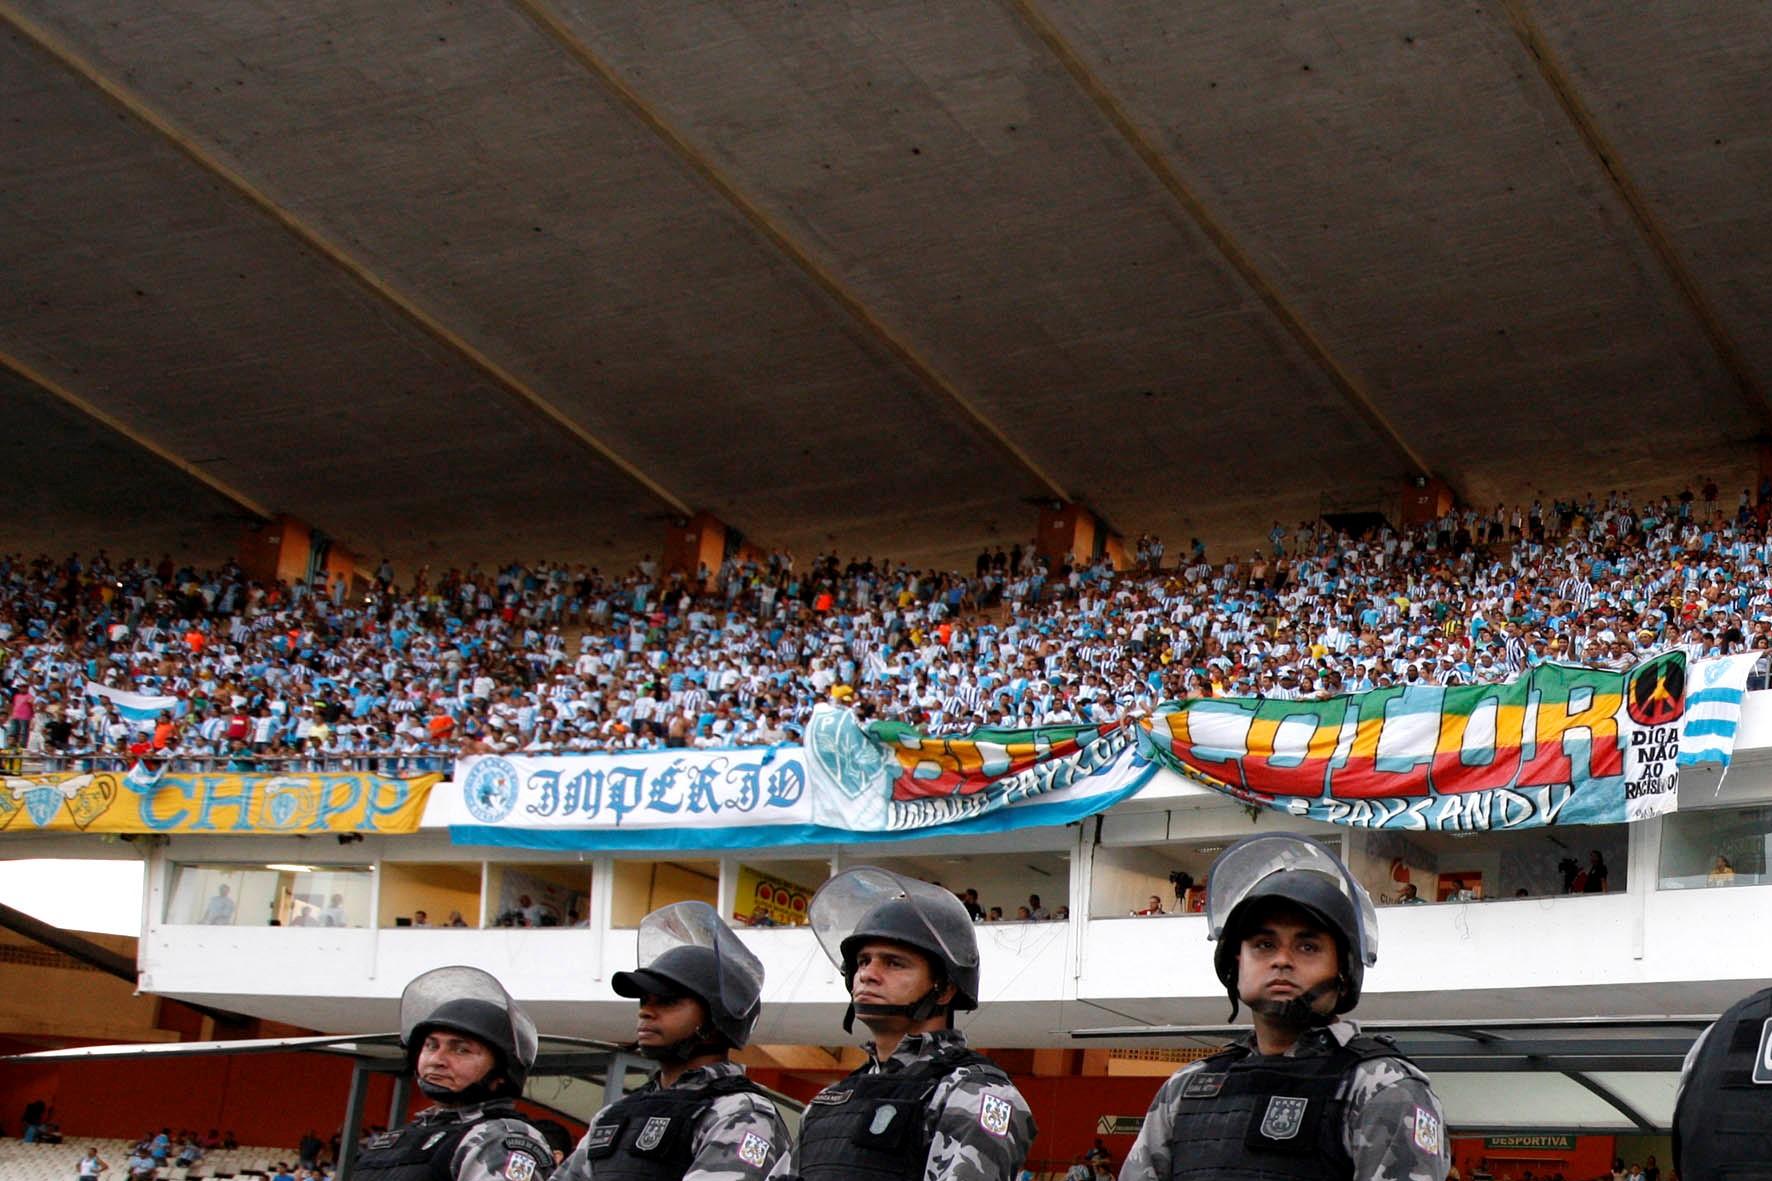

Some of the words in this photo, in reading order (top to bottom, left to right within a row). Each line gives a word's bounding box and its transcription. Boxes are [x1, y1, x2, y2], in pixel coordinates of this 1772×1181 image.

[1164, 663, 1624, 797] COLOR
[140, 775, 409, 832] CHOPP
[526, 756, 806, 827] IMPÉRIO
[1638, 762, 1664, 781] AO
